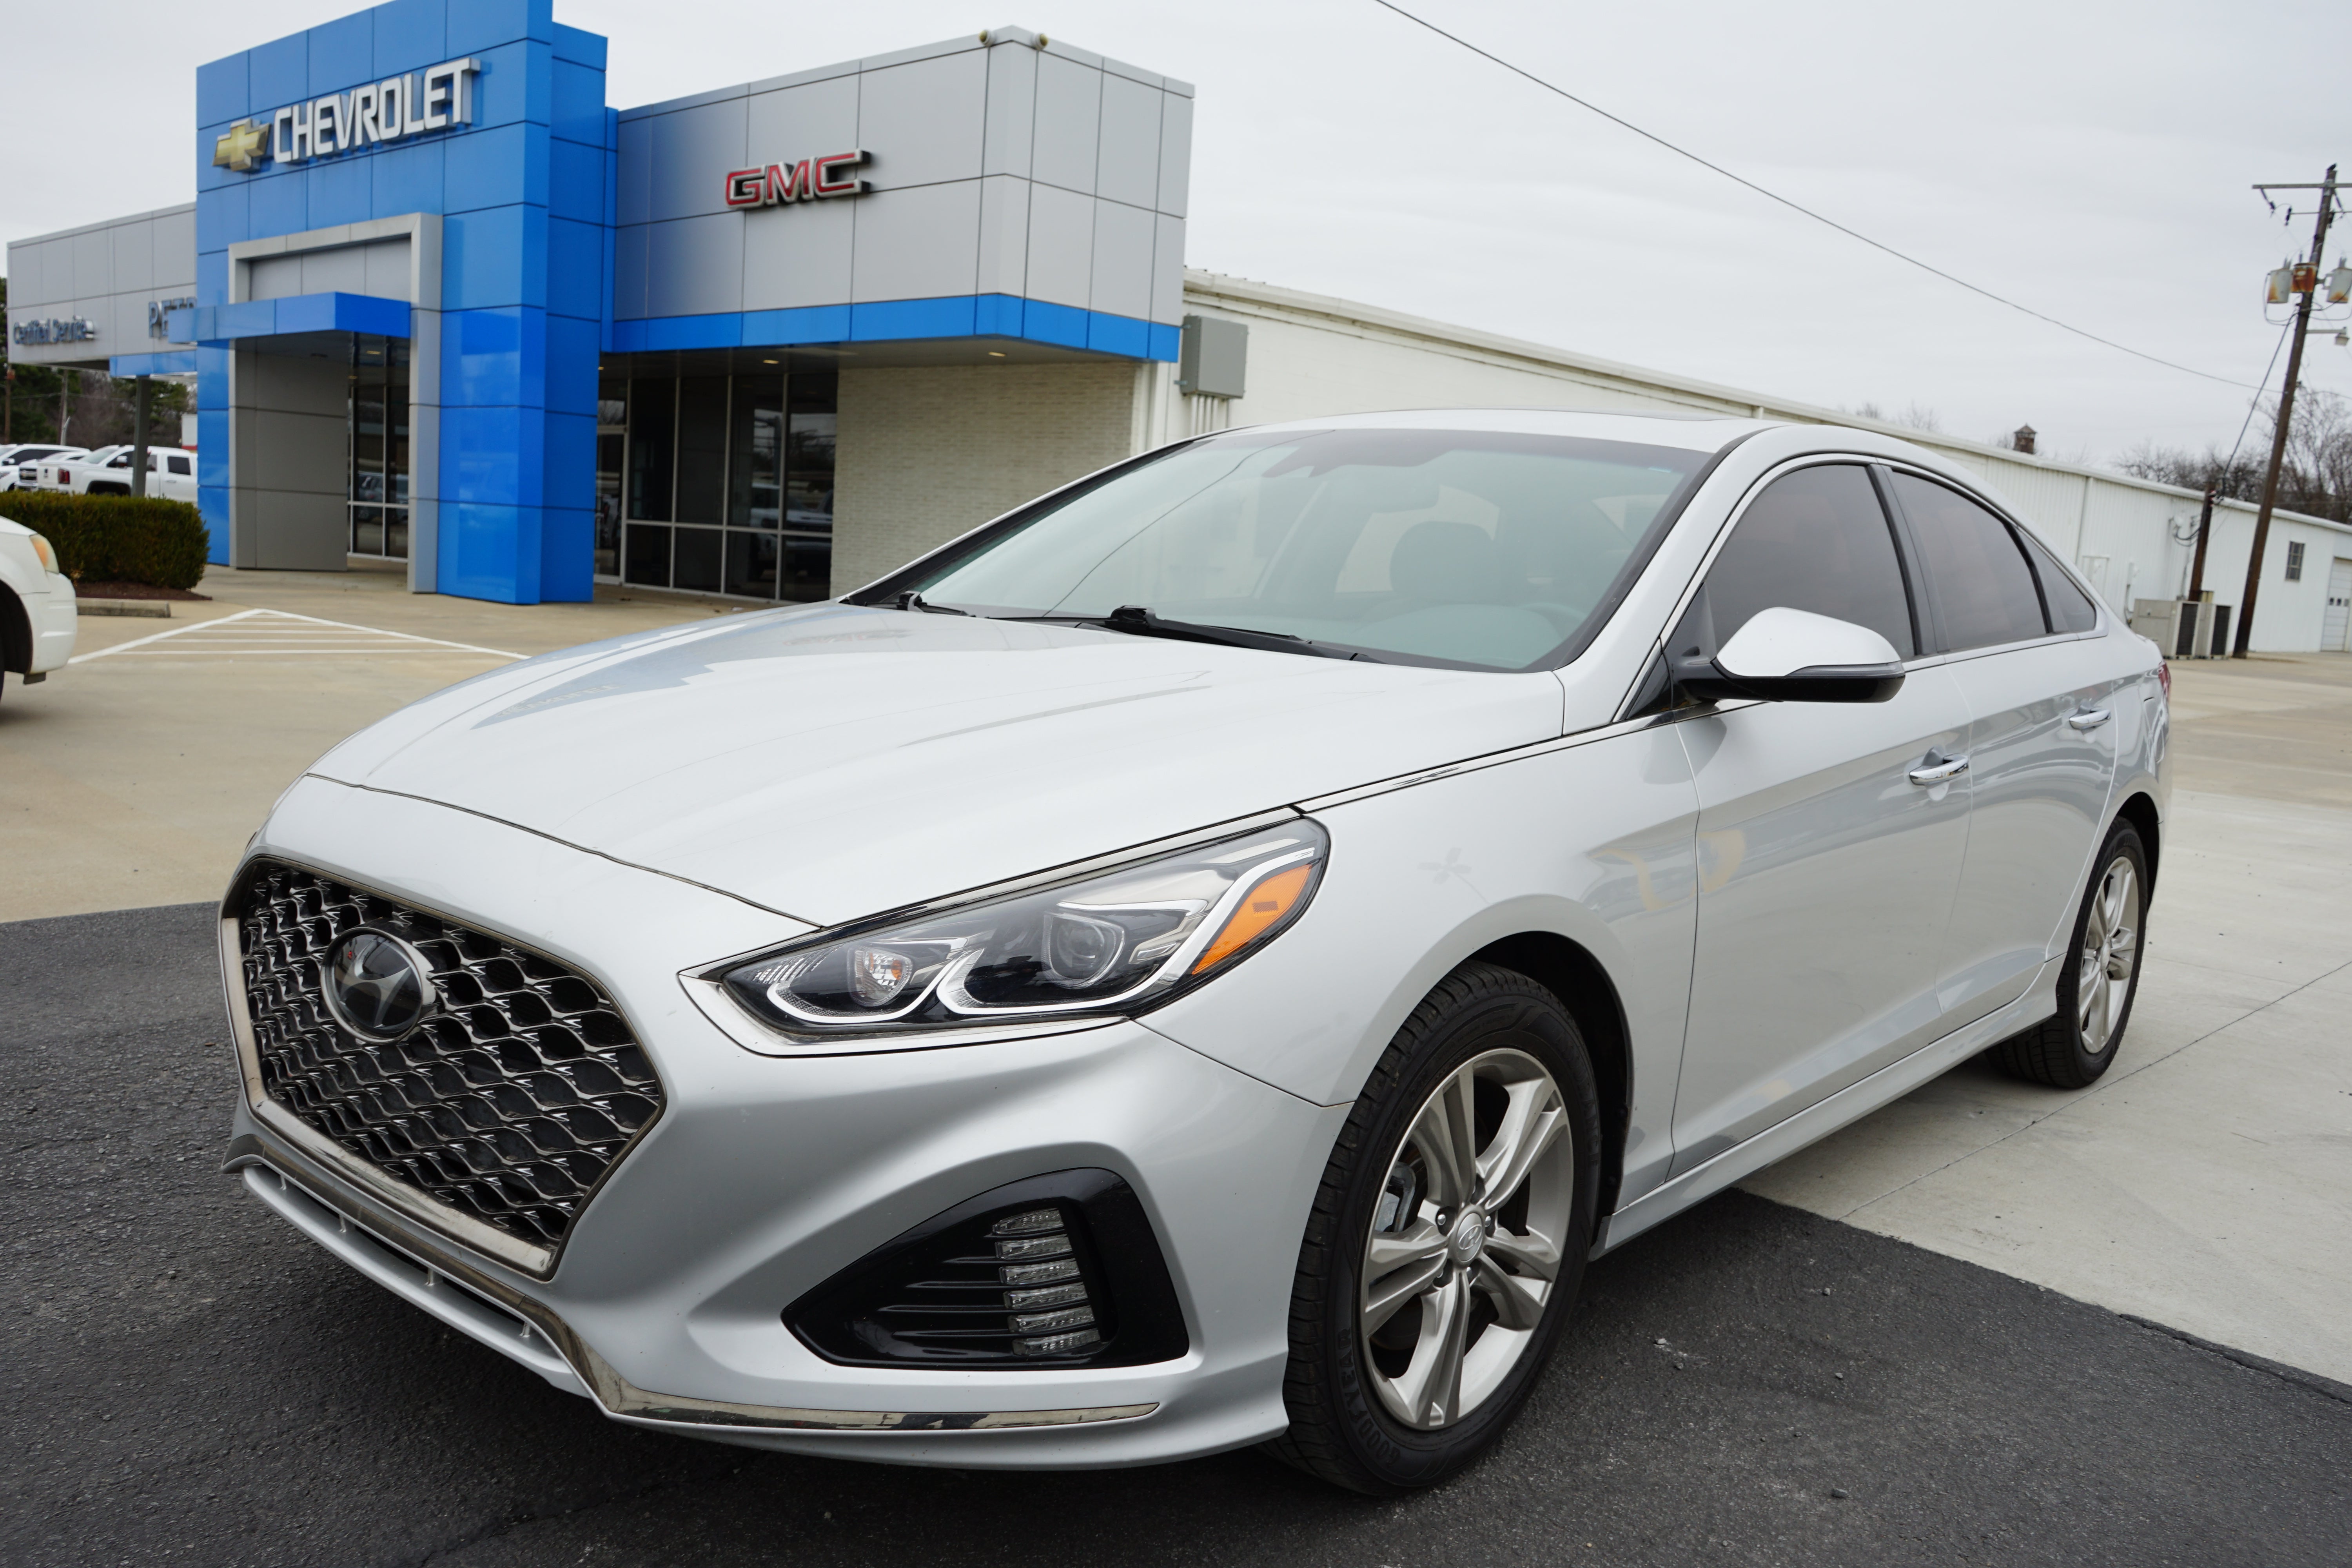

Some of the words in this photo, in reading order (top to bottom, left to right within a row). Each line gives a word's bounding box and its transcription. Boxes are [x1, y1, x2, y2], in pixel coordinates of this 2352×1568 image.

[273, 57, 473, 163] CHEVROLET
[725, 148, 866, 209] GMC
[1338, 1327, 1401, 1468] GOODYEAR
